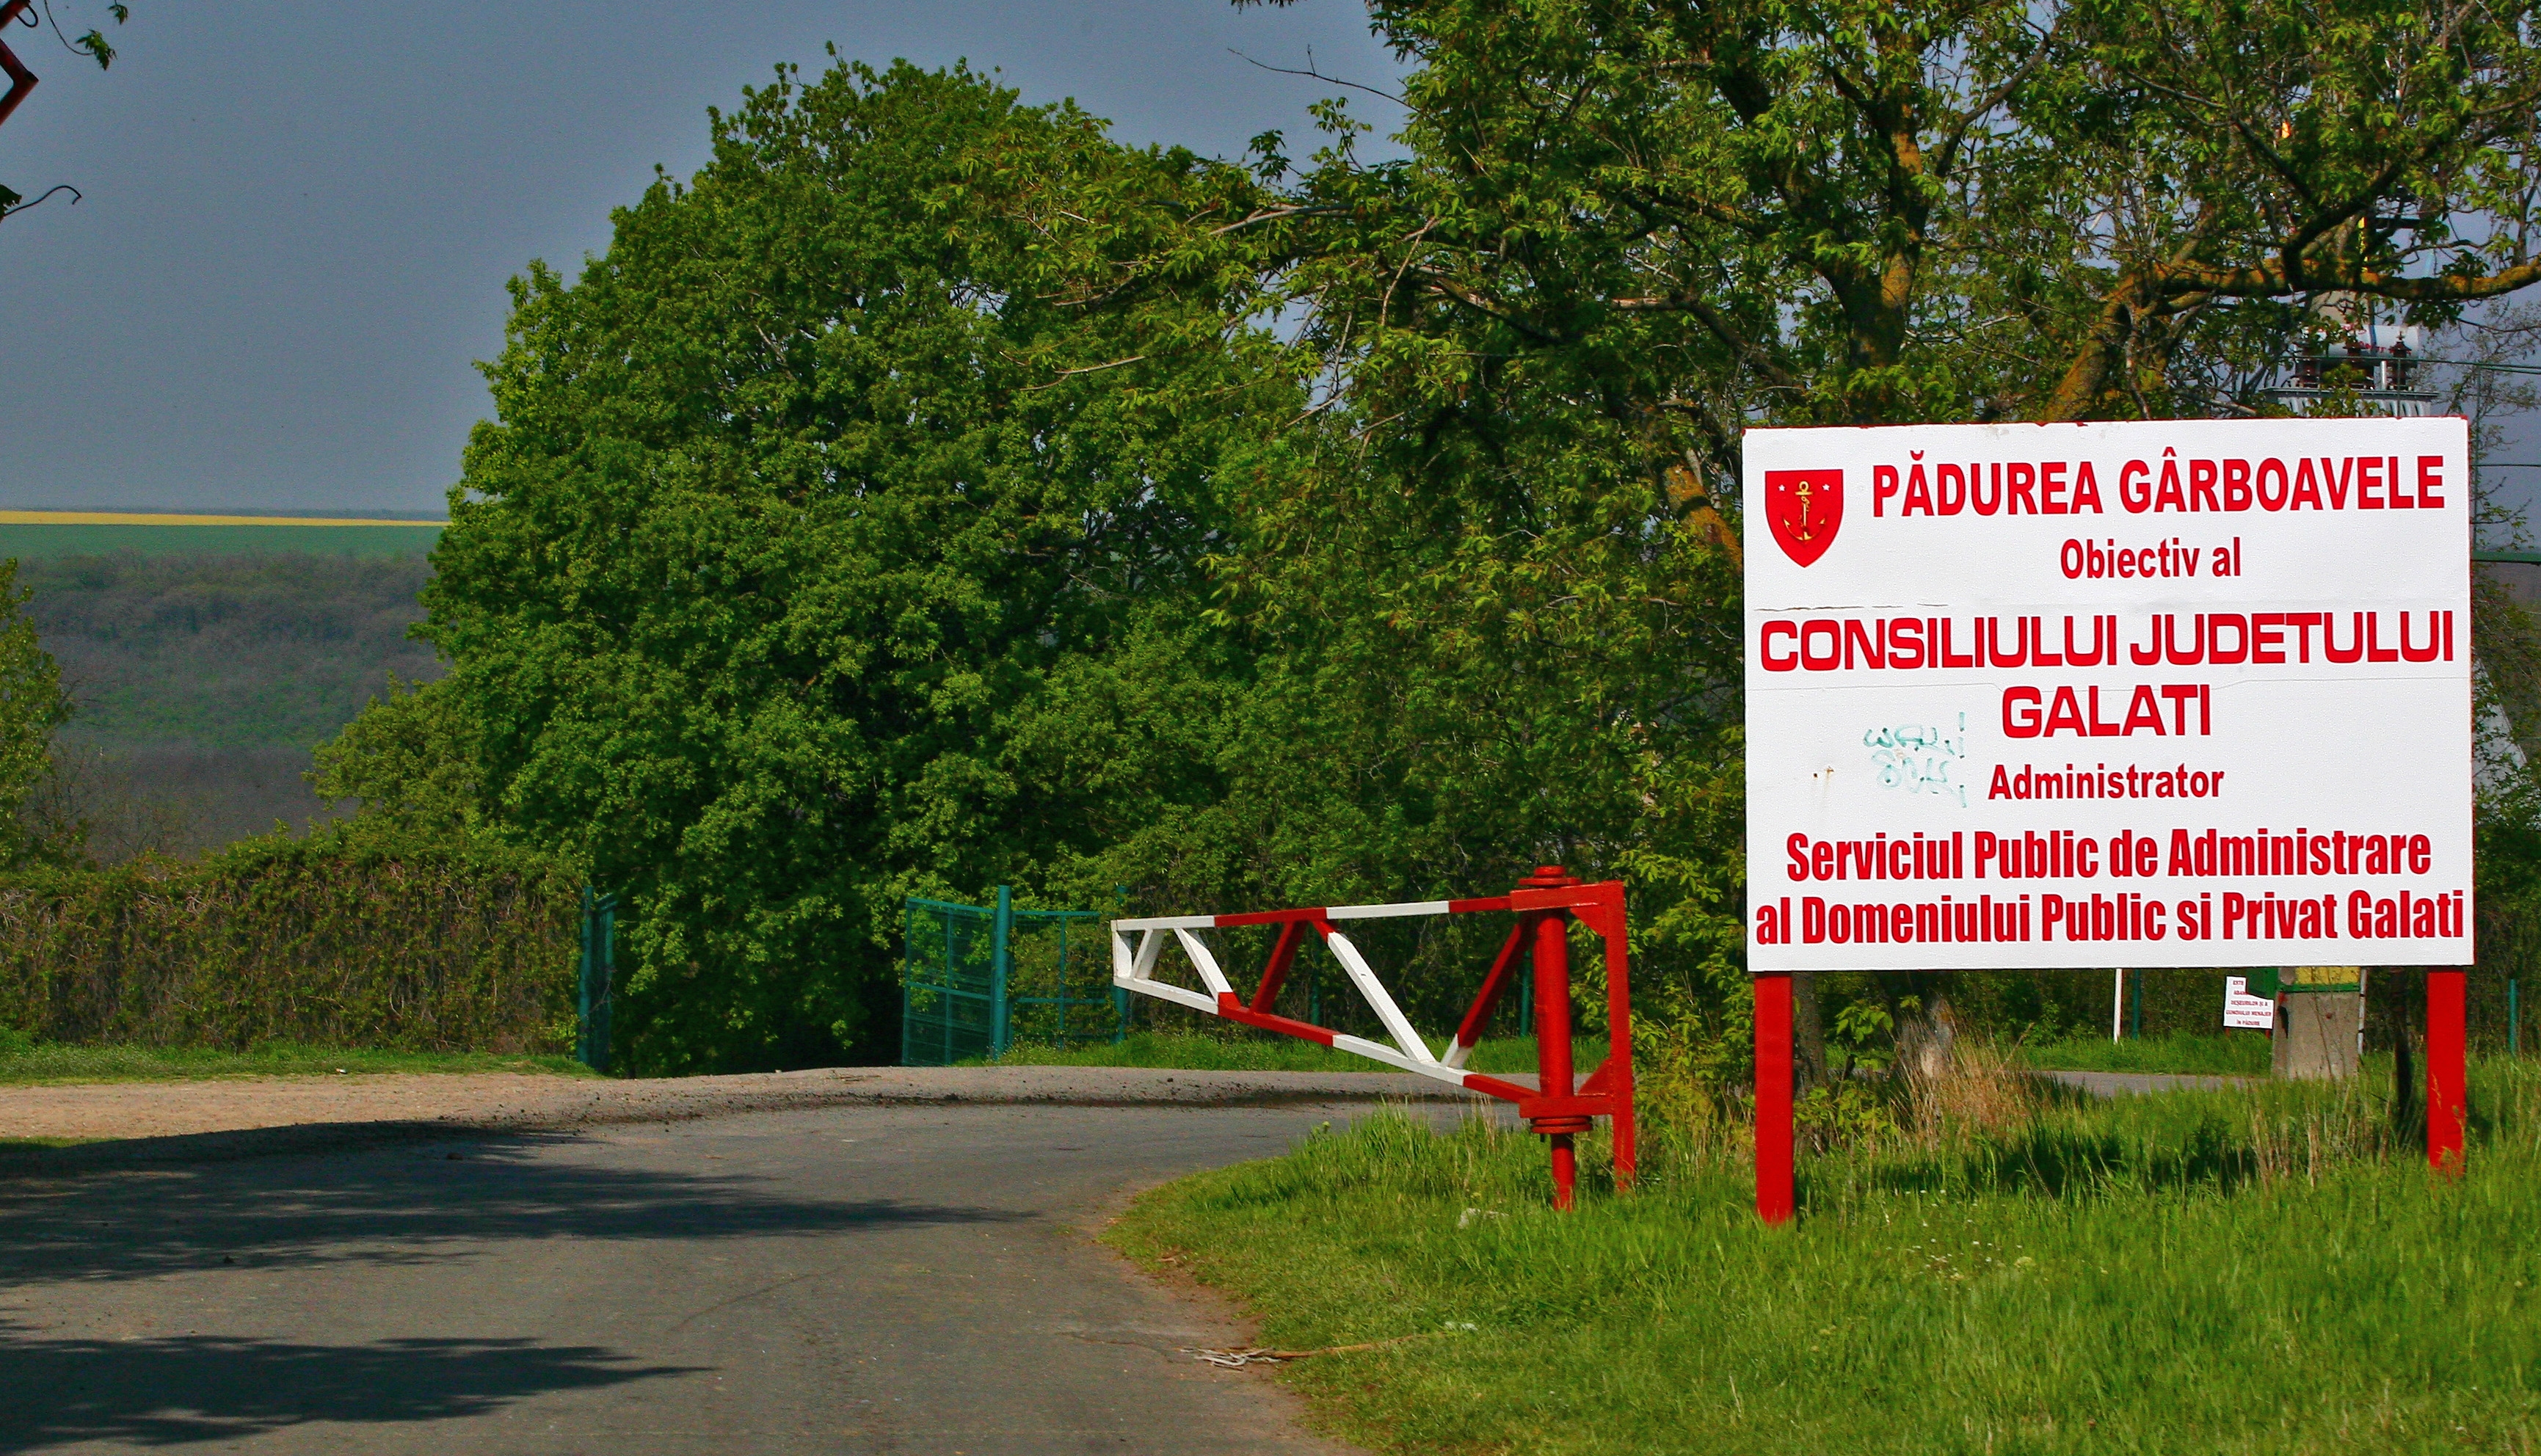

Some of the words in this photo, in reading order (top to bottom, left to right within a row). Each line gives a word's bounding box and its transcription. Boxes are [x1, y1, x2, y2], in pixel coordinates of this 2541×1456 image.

[1873, 451, 2104, 518] PĂDUREA
[2119, 445, 2445, 514] GÂRBOAVELE
[2060, 536, 2200, 580] Obiectiv
[2211, 536, 2241, 578] al
[1760, 614, 2118, 672] CONSILIULUI
[2129, 610, 2454, 666] JUDETULUI
[2002, 683, 2211, 739] GALATI
[1988, 762, 2225, 801] Administrator
[1786, 831, 1963, 882] Serviciul
[1974, 829, 2099, 880] Public
[2109, 829, 2159, 878] de
[2167, 827, 2432, 877] Administrare
[1756, 896, 1792, 945] al
[1802, 893, 2031, 944] Domeniului
[2041, 892, 2167, 942] Public
[2176, 892, 2211, 942] si
[2222, 891, 2338, 940] Privat
[2347, 889, 2464, 940] Galati
